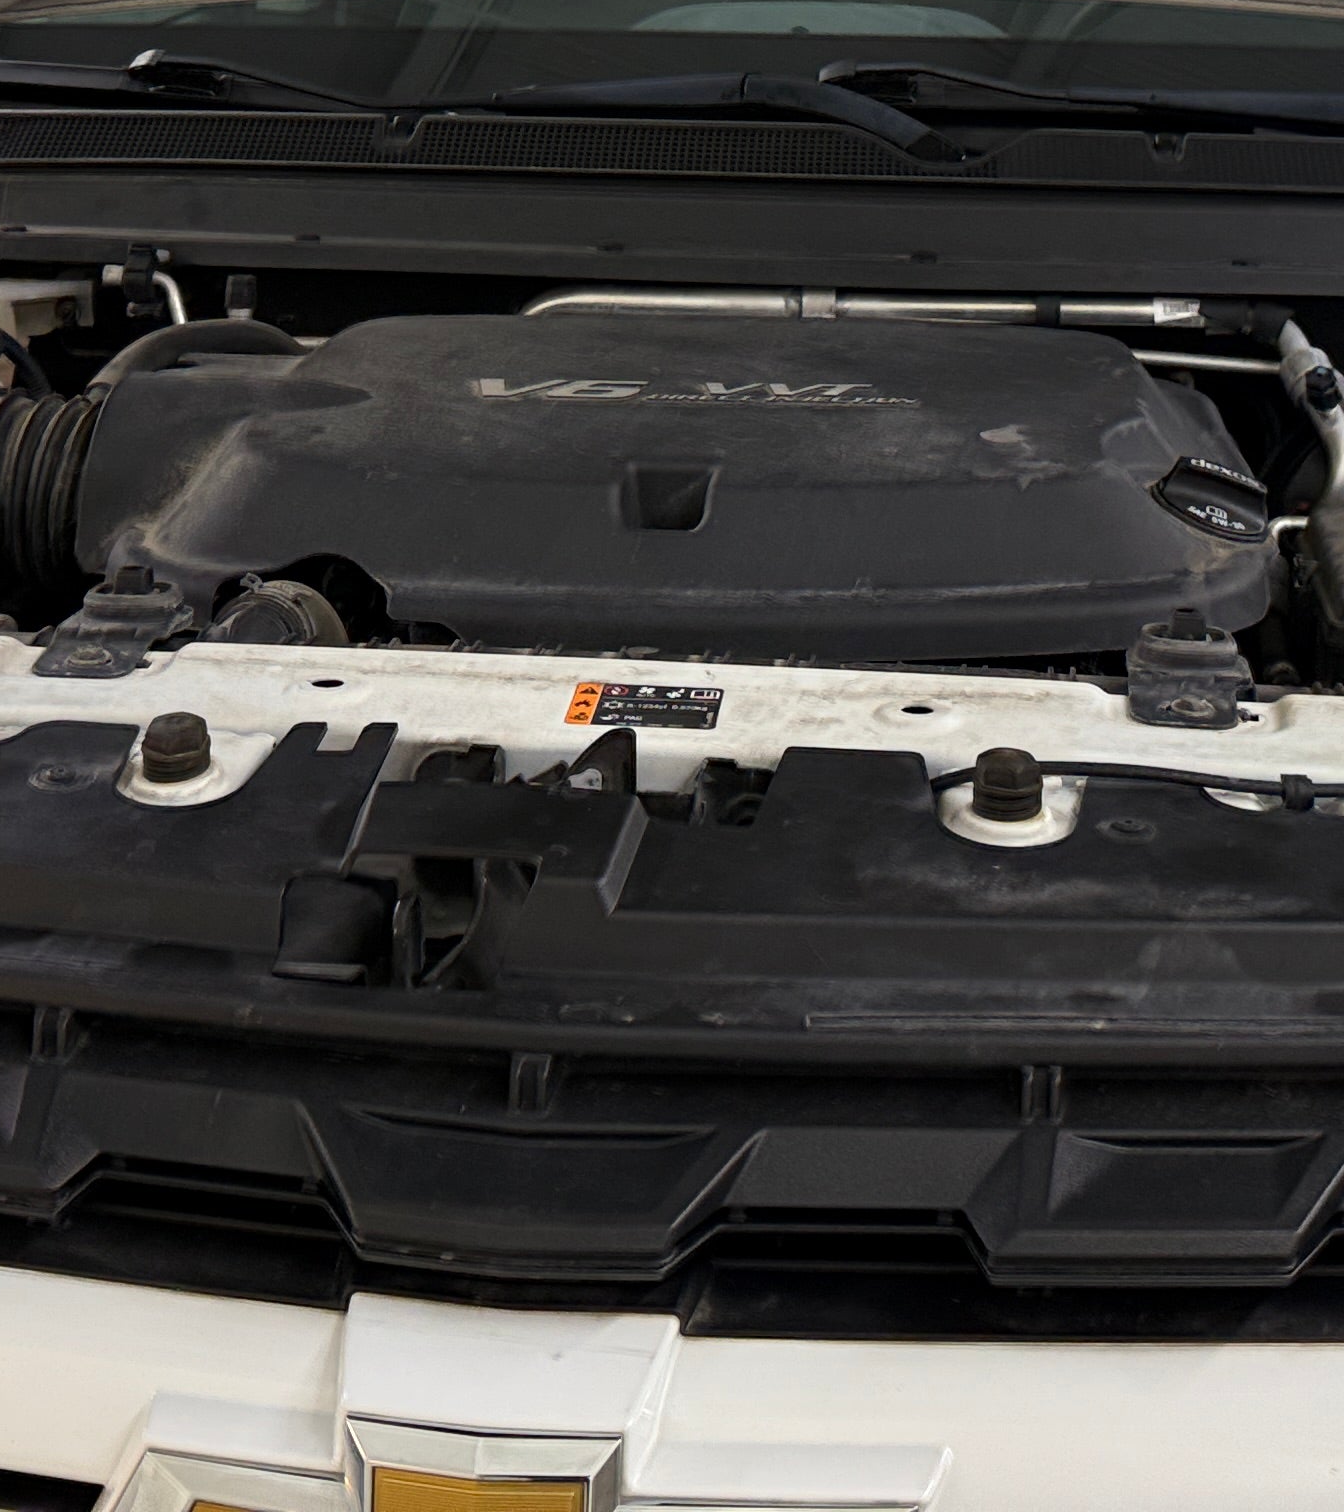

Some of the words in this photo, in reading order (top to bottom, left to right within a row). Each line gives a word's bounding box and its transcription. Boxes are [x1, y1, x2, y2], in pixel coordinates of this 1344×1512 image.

[478, 377, 649, 399] V6
[705, 382, 873, 396] VVT
[1190, 457, 1261, 488] dexos
